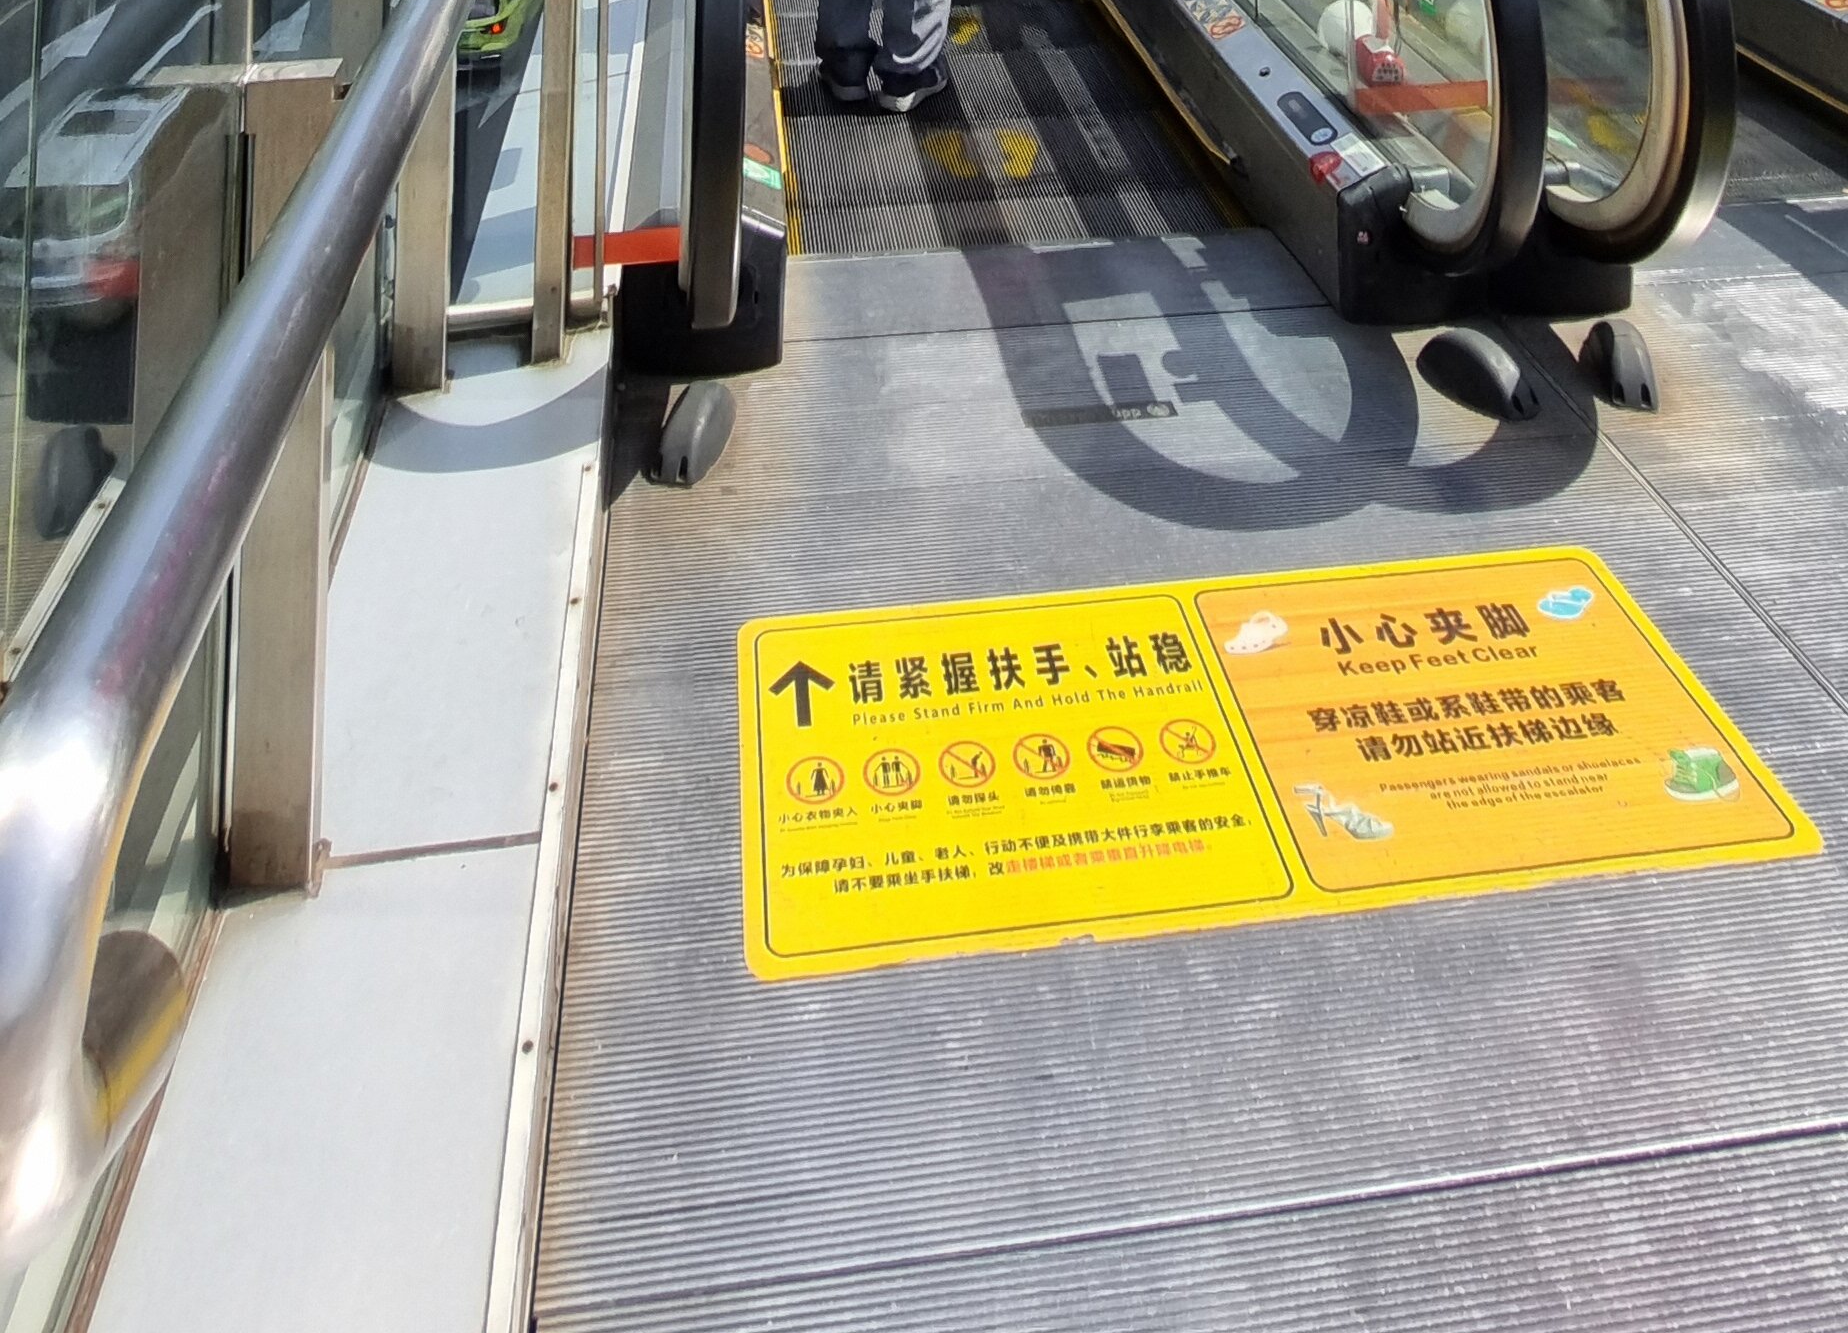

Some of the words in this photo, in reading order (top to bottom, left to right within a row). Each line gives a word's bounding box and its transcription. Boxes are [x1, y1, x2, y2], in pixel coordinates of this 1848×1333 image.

[1320, 602, 1531, 655] 小心夹脚
[848, 631, 1194, 706] 请紧握扶手、站稳
[1337, 658, 1407, 677] Keep
[1409, 649, 1469, 671] Feet
[1471, 642, 1538, 663] Clear
[852, 712, 906, 726] Please
[912, 703, 962, 721] Stand
[967, 699, 1006, 716] Firm
[1012, 694, 1045, 711] And
[1051, 689, 1091, 707] Hold
[1096, 687, 1127, 703] The
[1133, 678, 1205, 699] Handrail
[1306, 677, 1627, 733] 穿凉鞋或系鞋带的乘客
[1354, 712, 1620, 764] 请勿站近扶梯边缘
[1379, 776, 1457, 792] Passengers
[1457, 770, 1511, 785] wearing
[1511, 765, 1561, 779] sandals
[1561, 764, 1575, 773] or
[1577, 756, 1642, 771] shoelaces
[1430, 790, 1452, 801] are
[1453, 786, 1475, 798] not
[1477, 781, 1526, 796] allowed
[1527, 779, 1542, 790] to
[1543, 773, 1580, 788] stand
[1580, 773, 1609, 785] near
[870, 798, 924, 815] 小心夹脚
[1446, 799, 1469, 811] the
[1471, 793, 1503, 808] edge
[1504, 791, 1518, 803] of
[1519, 791, 1543, 802] the
[1544, 785, 1604, 799] escalator
